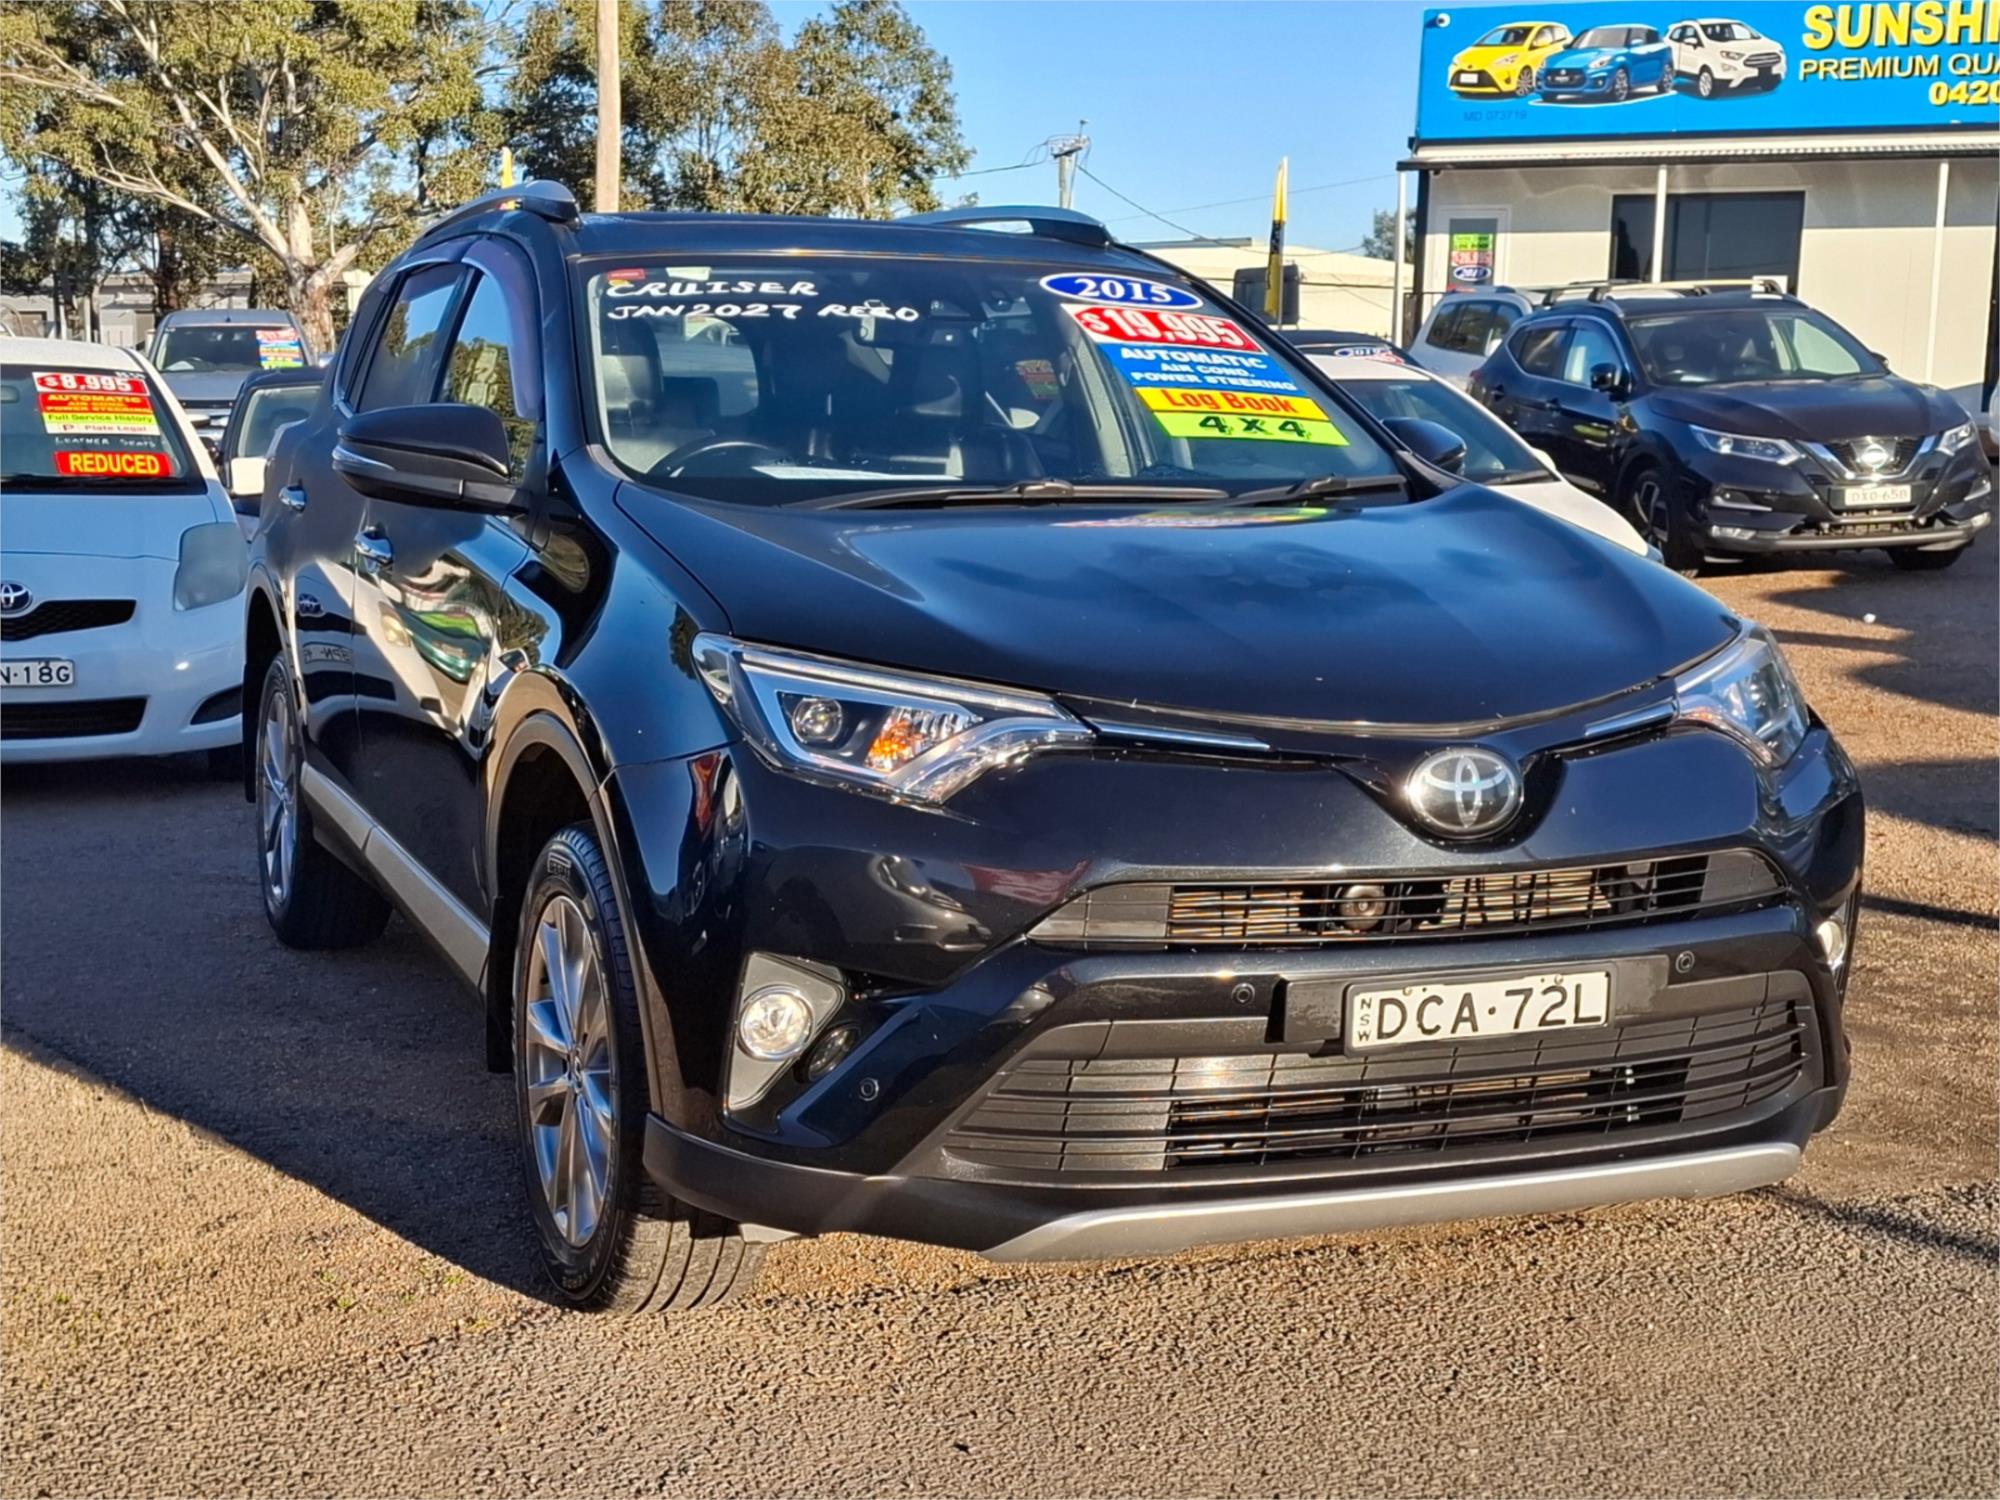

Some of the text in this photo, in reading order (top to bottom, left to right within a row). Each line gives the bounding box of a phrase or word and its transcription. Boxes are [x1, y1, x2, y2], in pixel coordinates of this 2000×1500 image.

[1799, 52, 2000, 80] PREMIUM QU
[606, 281, 819, 298] CRUISER
[1074, 278, 1172, 302] 2015
[1081, 309, 1245, 347] $19,995
[1120, 347, 1268, 370] AUTOMATIC
[1161, 362, 1255, 378] AIR COND.
[1130, 371, 1299, 392] POWER STEERING
[48, 394, 142, 403] AUTOMATIC
[1161, 388, 1300, 414] Log Book
[114, 415, 153, 423] History
[69, 453, 160, 475] REDUCED
[1357, 997, 1373, 1043] NSW
